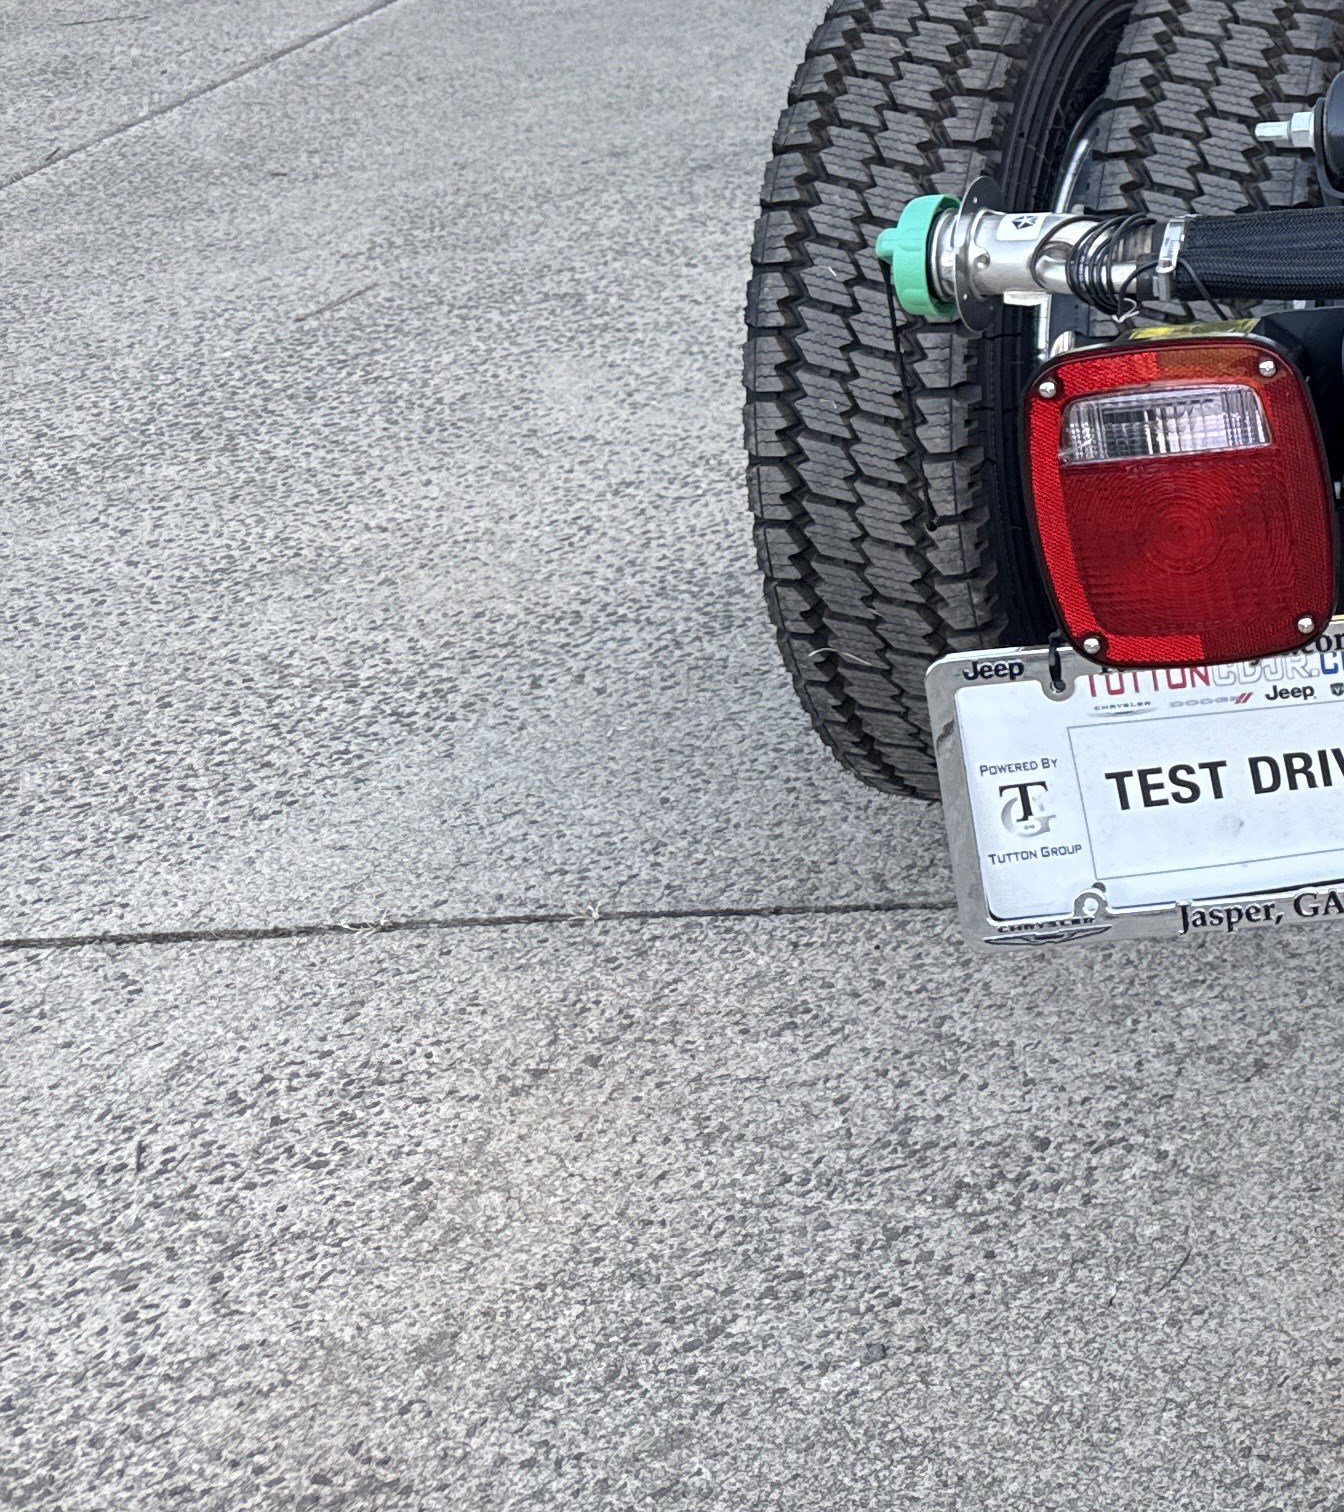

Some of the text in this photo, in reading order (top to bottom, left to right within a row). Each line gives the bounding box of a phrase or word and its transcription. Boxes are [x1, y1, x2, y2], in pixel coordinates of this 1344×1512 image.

[962, 659, 1025, 681] Jeep
[1093, 700, 1152, 711] CHRYSLER
[1265, 684, 1316, 701] Jeep
[1104, 760, 1228, 811] TEST
[1178, 900, 1284, 934] Jasper,
